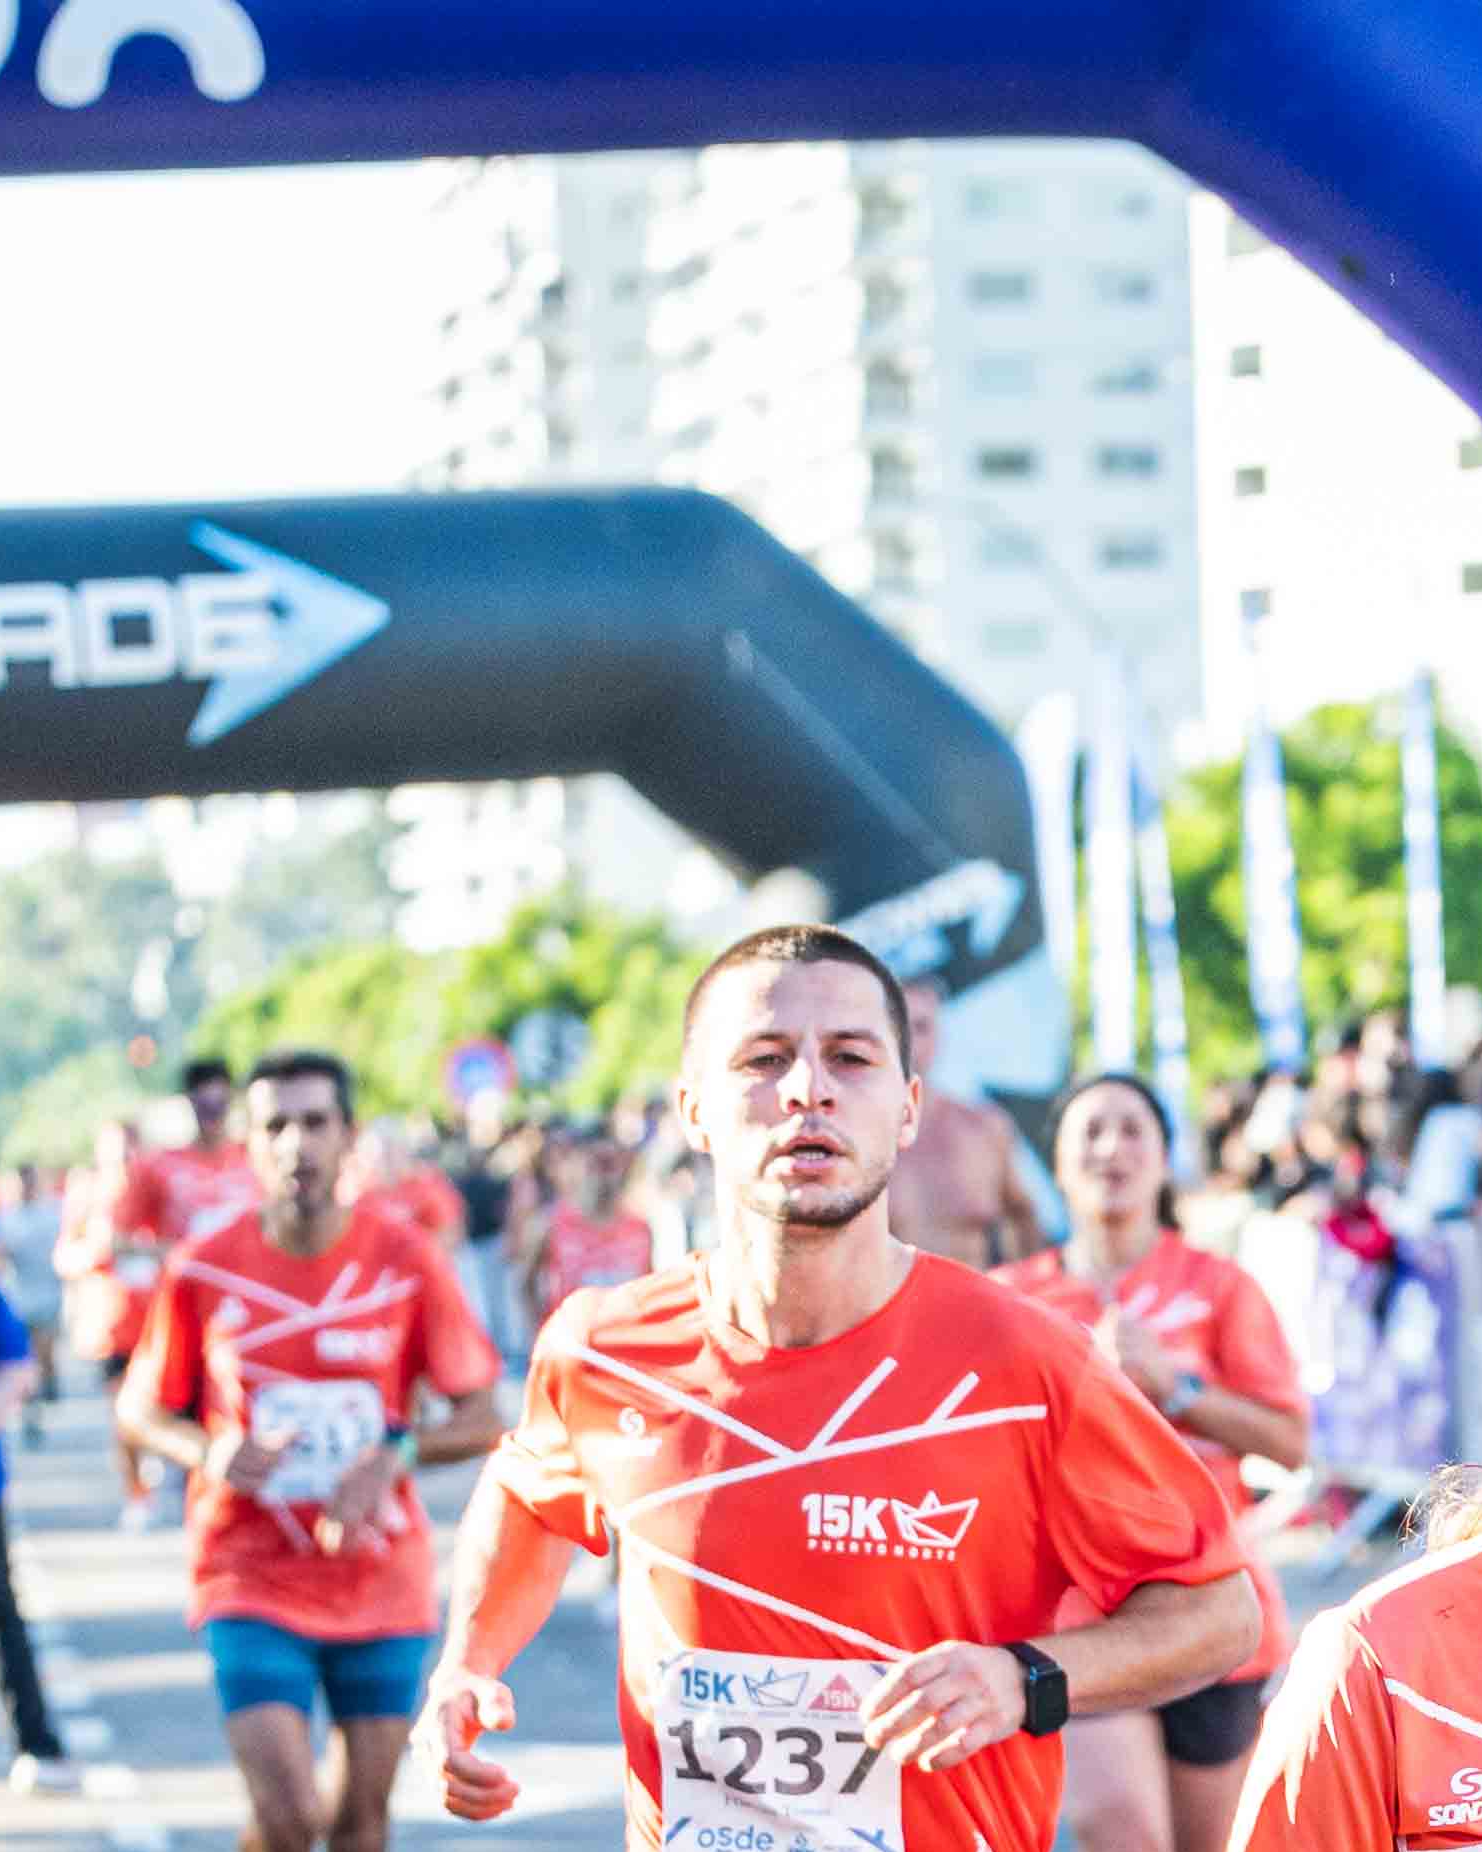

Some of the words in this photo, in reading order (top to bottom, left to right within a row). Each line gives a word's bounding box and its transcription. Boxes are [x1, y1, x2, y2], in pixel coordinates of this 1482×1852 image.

[801, 1492, 889, 1541] 15K
[679, 1667, 736, 1705] 15K
[667, 1718, 884, 1797] 1237
